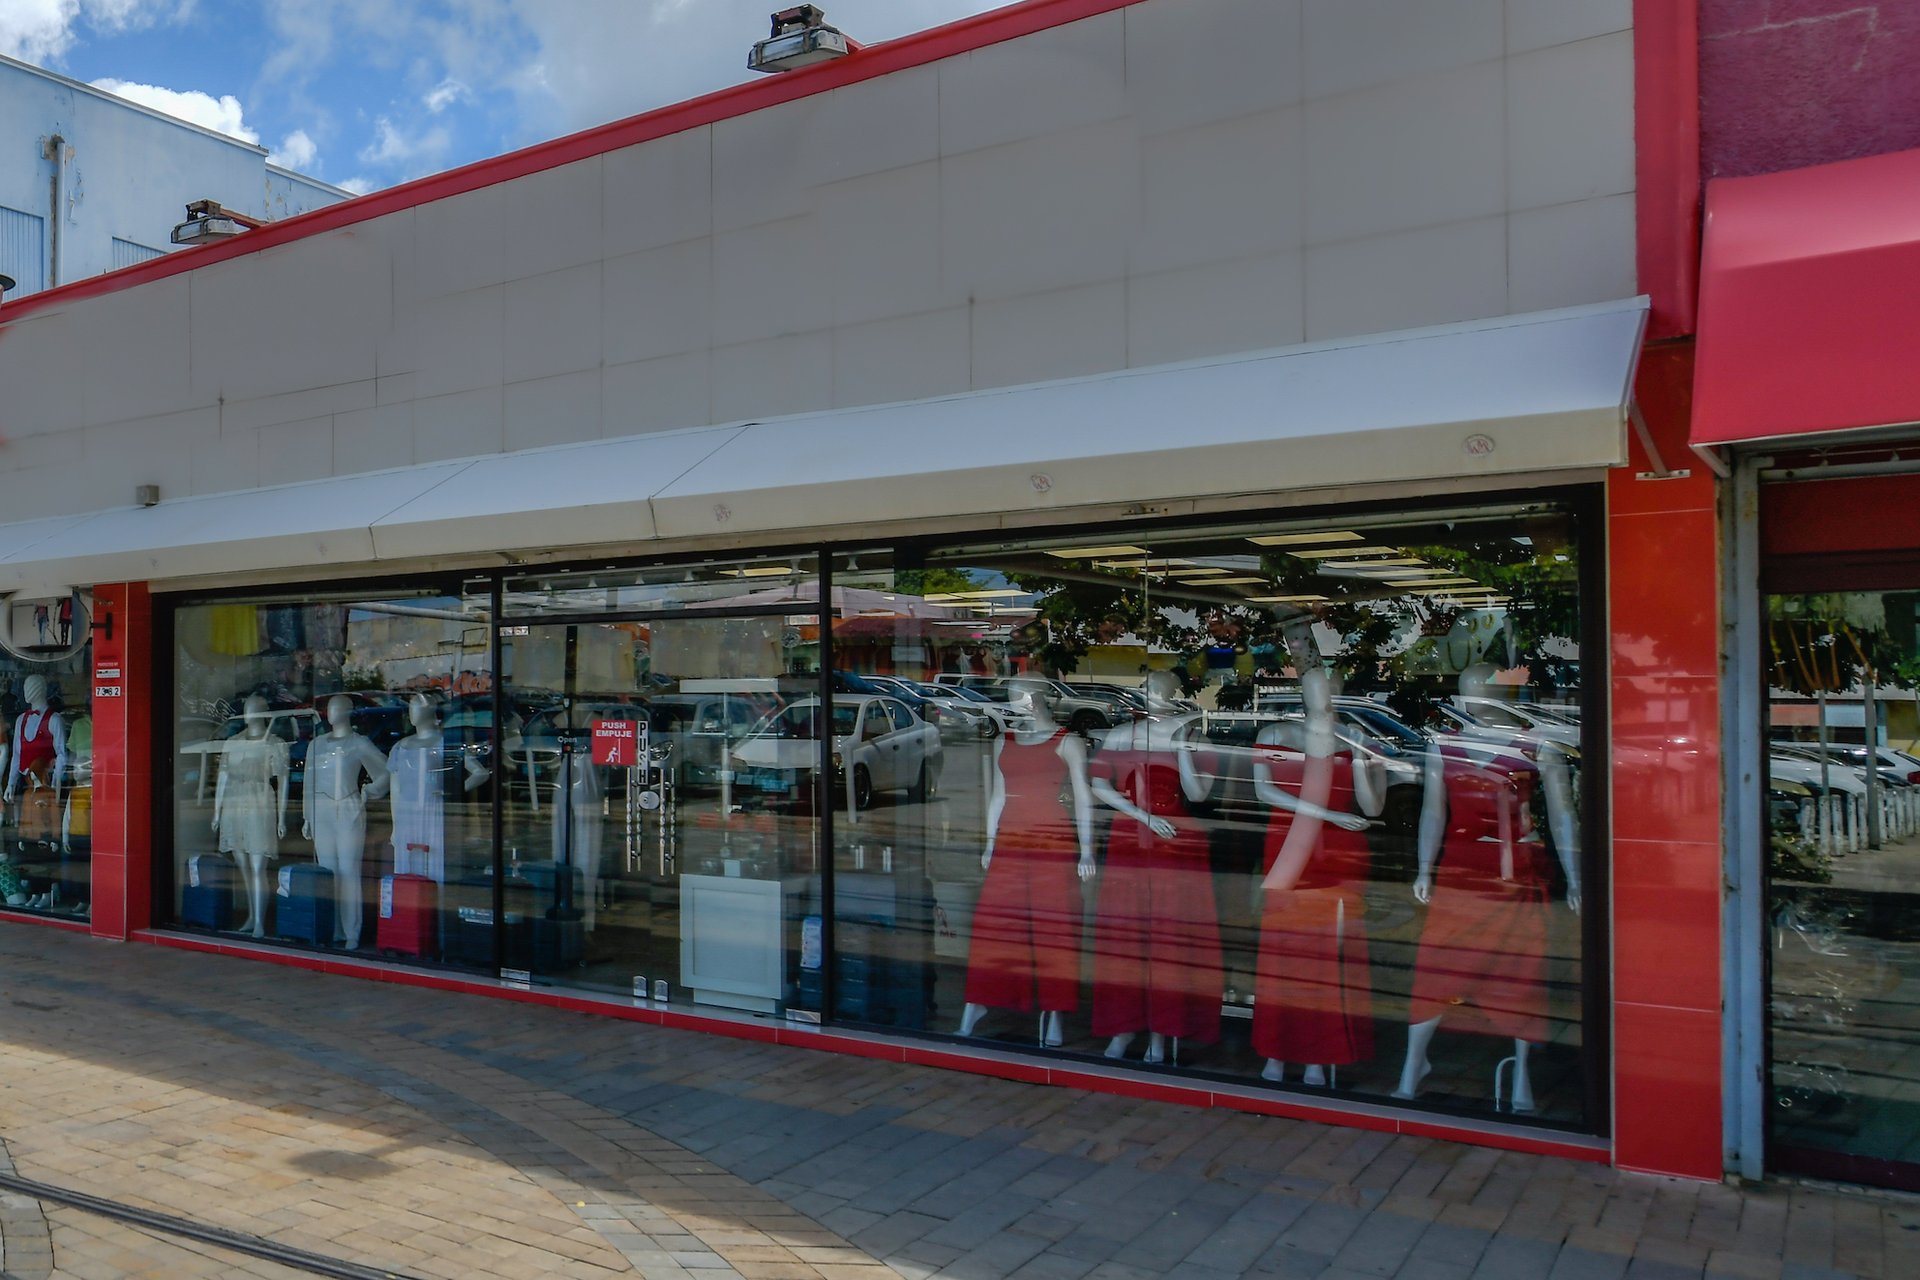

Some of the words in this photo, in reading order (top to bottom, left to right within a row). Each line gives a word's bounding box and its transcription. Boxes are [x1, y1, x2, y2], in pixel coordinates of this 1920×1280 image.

[601, 721, 626, 729] PUSH
[596, 729, 632, 738] EMPUJE
[557, 735, 578, 744] Open
